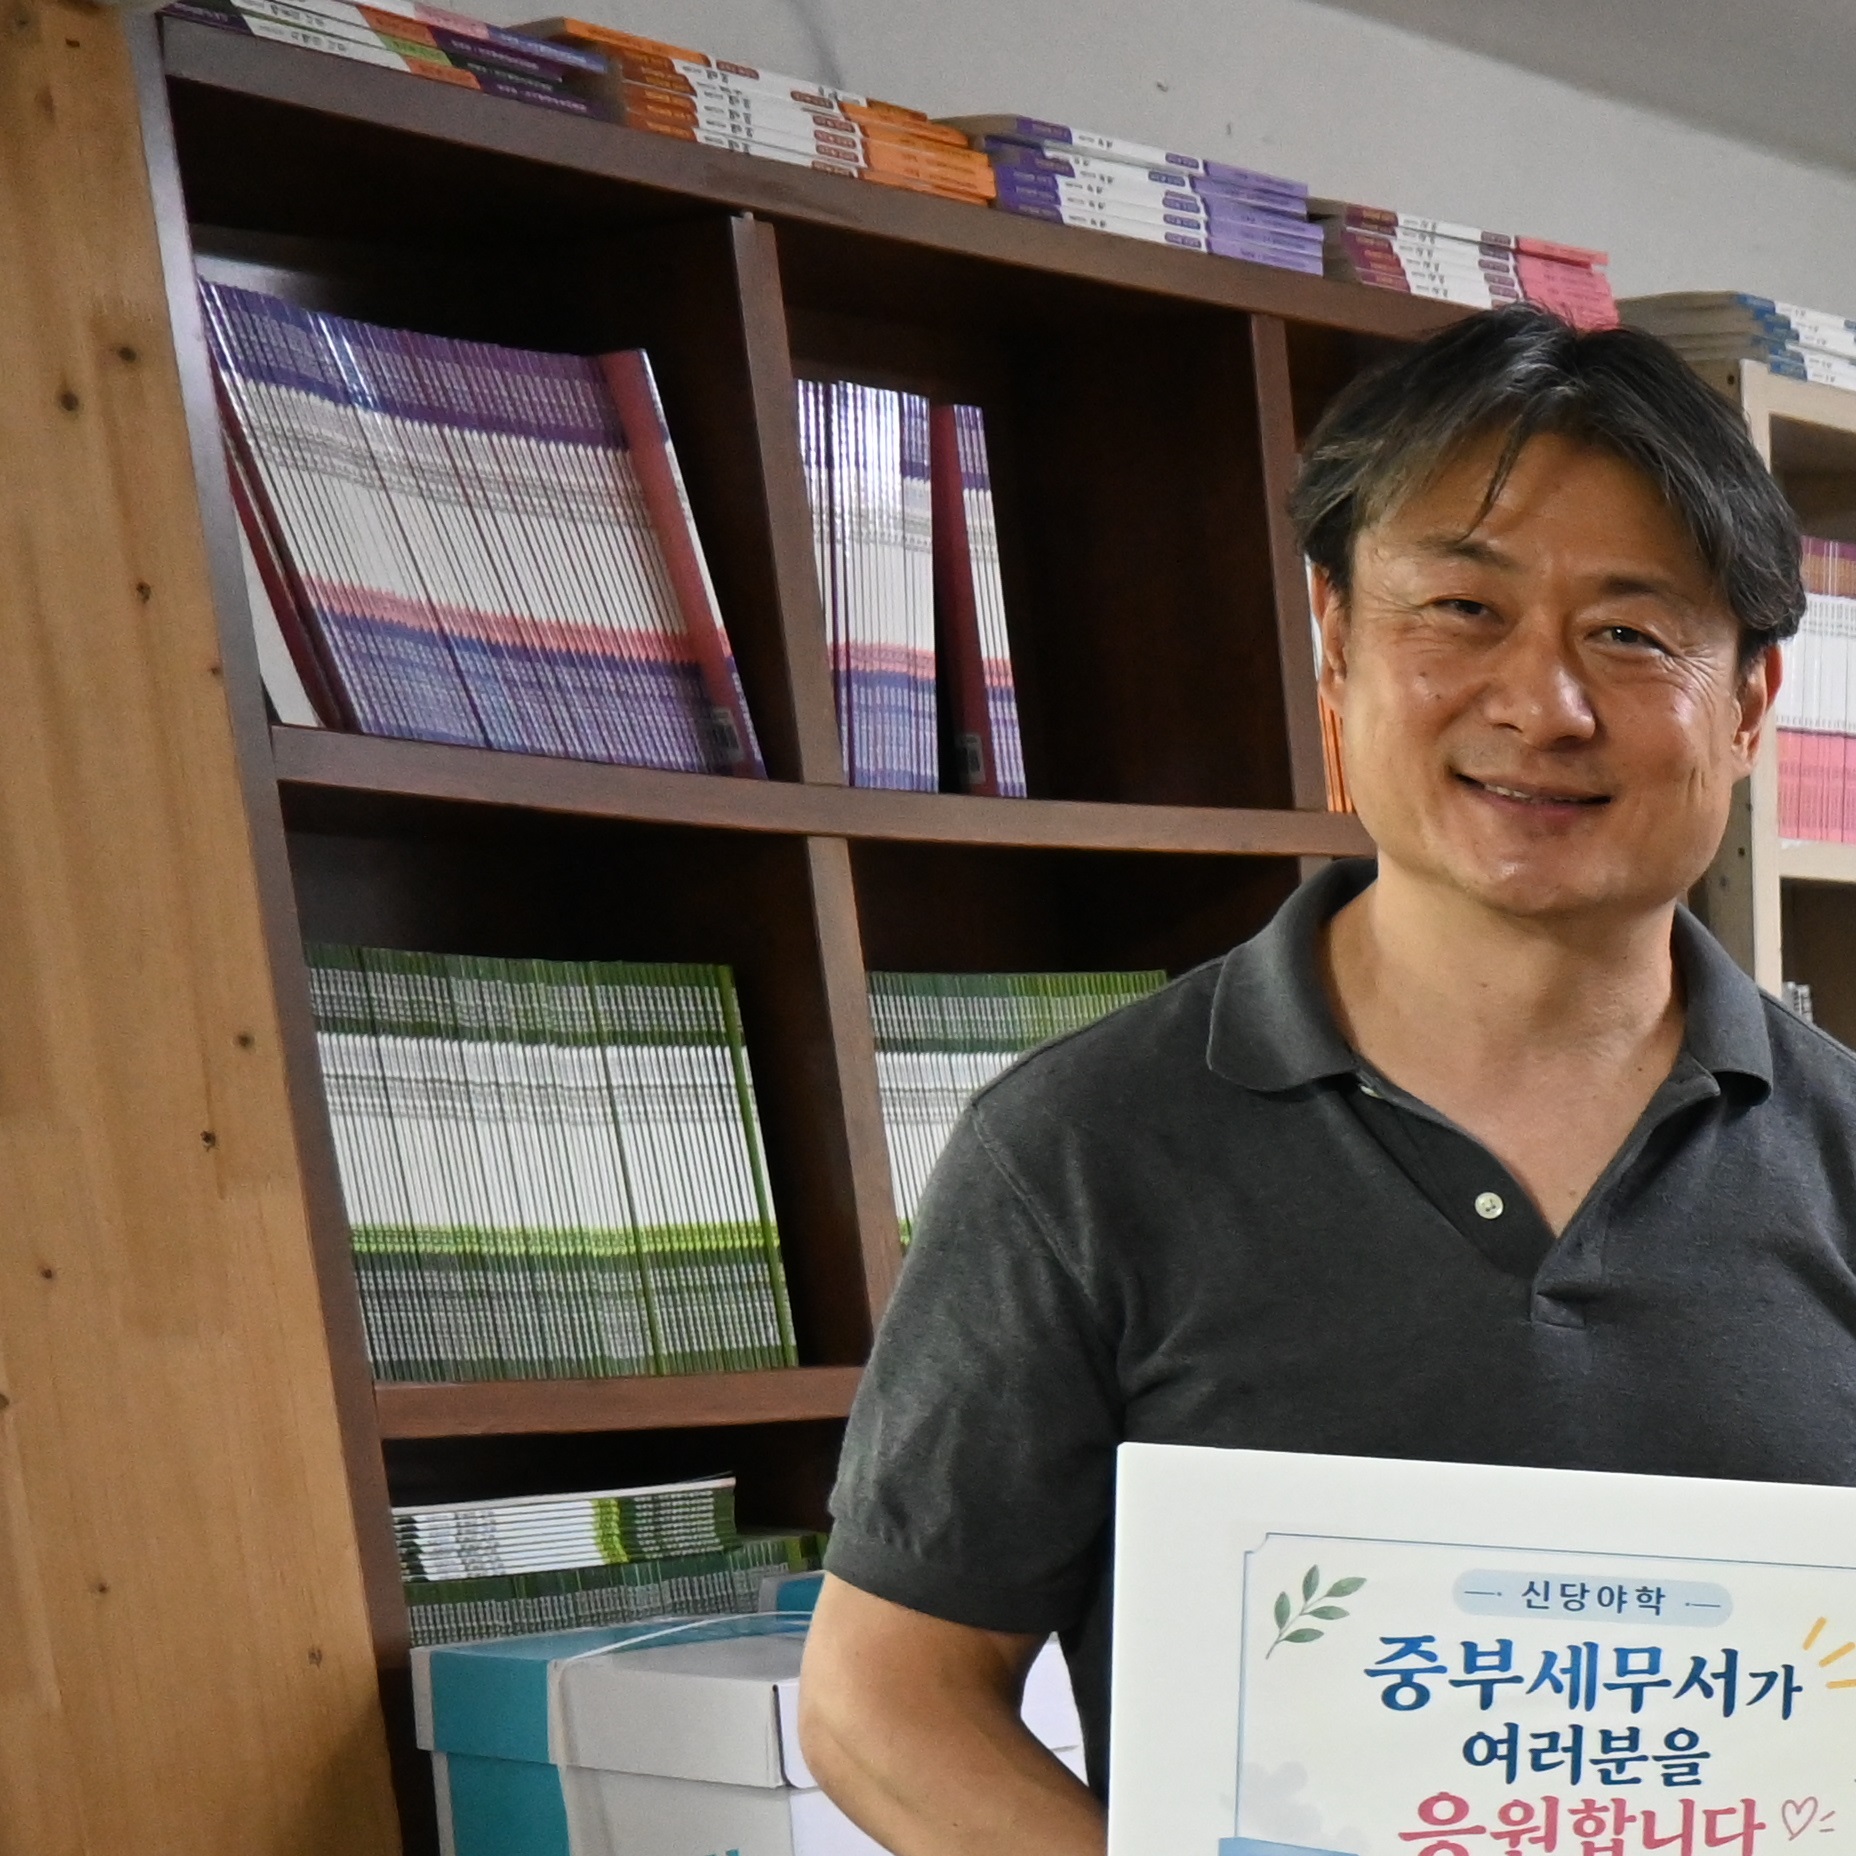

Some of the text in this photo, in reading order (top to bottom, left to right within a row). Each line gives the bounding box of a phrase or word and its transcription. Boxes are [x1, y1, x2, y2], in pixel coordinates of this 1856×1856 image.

[1522, 1581, 1667, 1617] 신당야학
[1364, 1635, 1803, 1721] 중부세무서가
[1462, 1722, 1712, 1788] 여러분을
